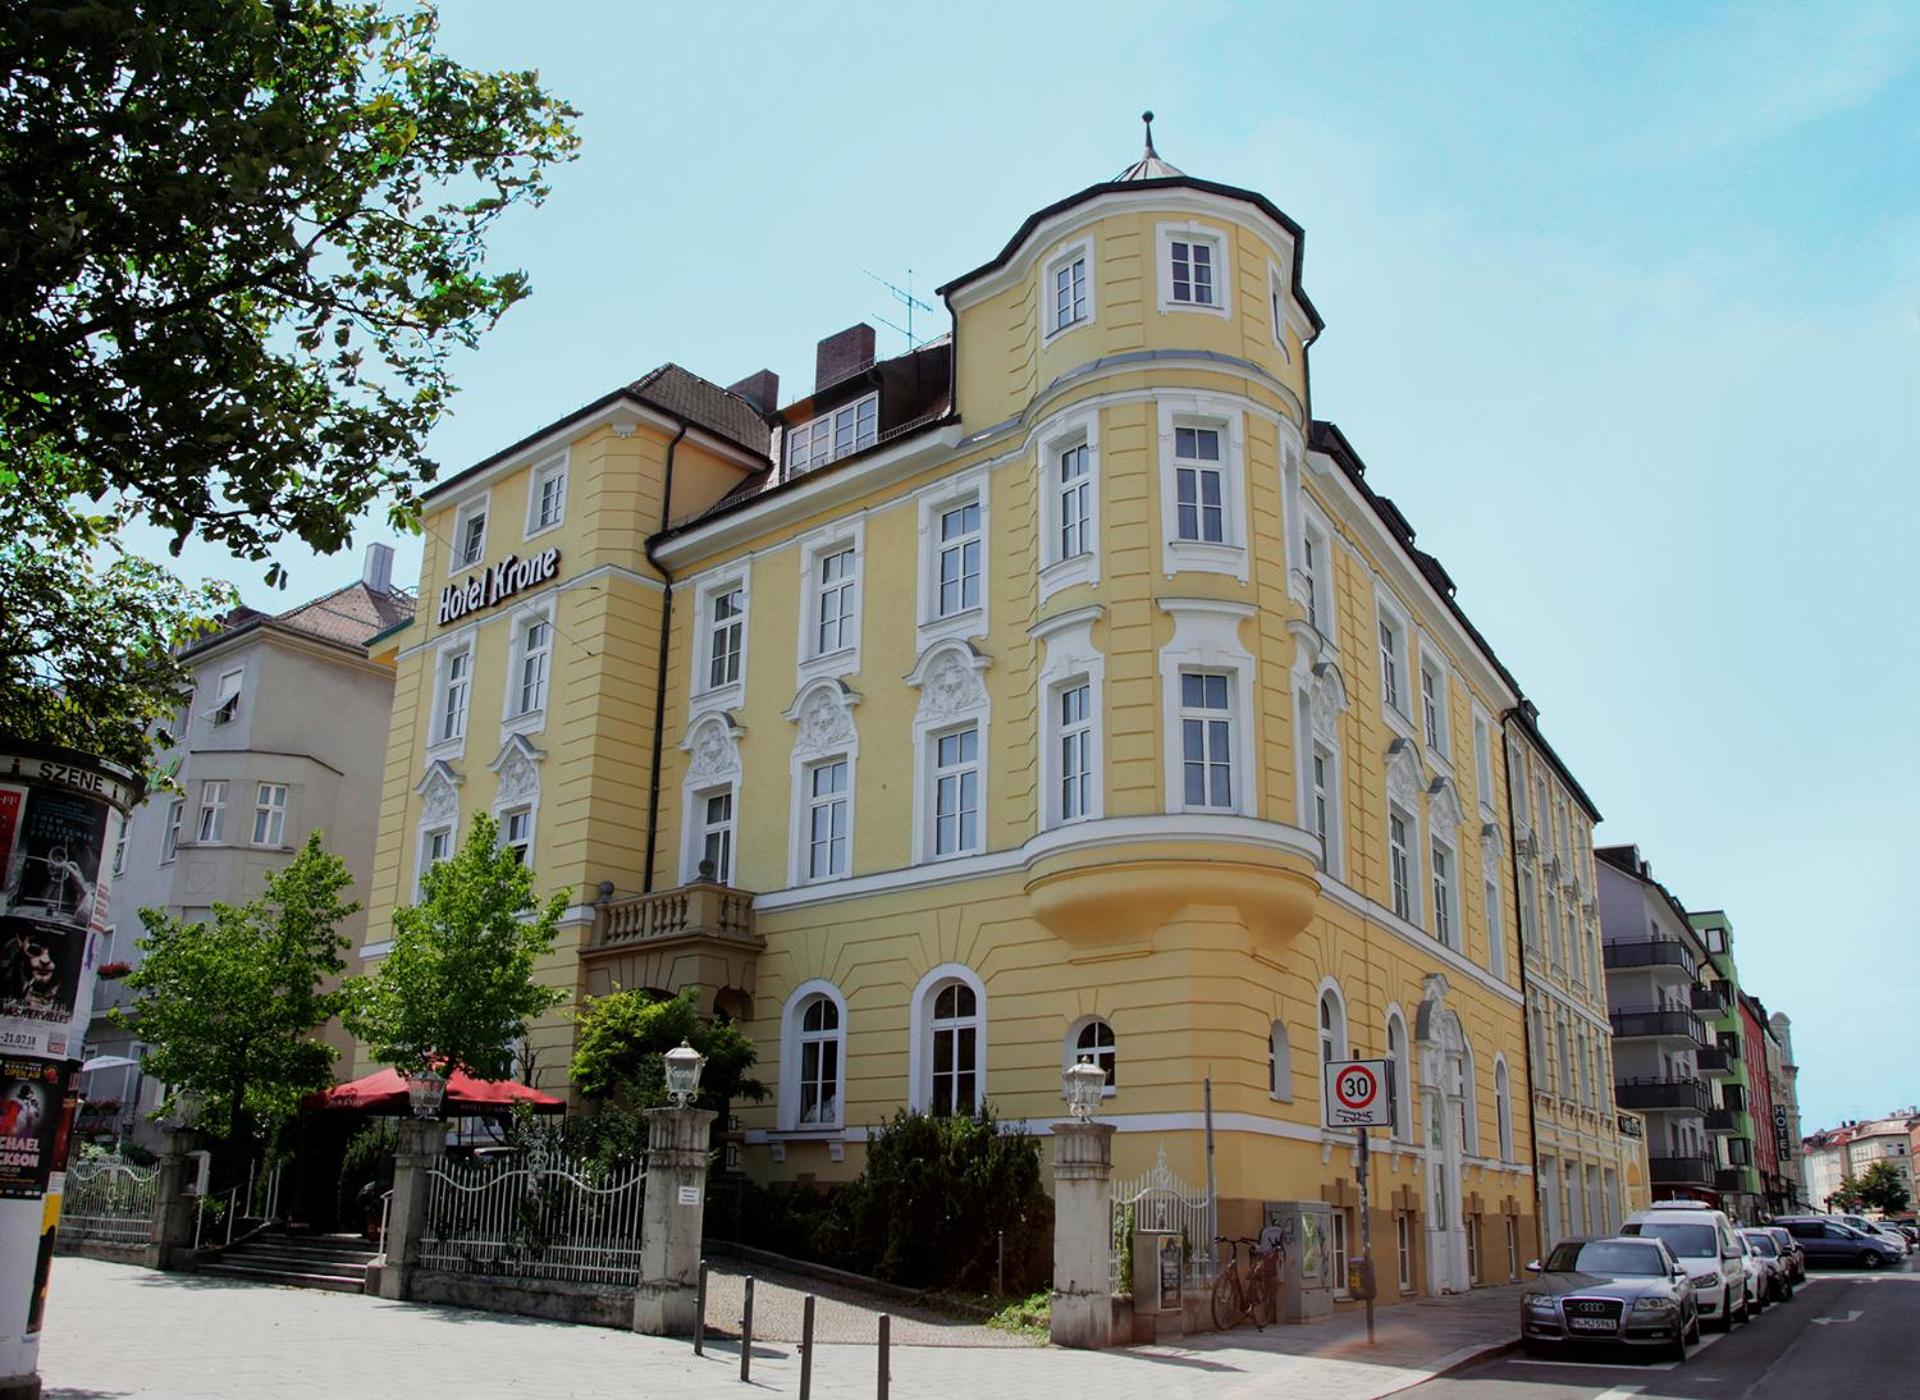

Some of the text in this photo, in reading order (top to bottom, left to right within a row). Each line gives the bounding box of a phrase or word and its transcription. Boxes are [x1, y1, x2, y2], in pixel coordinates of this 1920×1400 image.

[439, 548, 561, 625] Hotel Krone
[39, 762, 105, 793] SZENE
[4, 1069, 27, 1078] OPEN
[28, 1071, 41, 1080] AIR
[1344, 1077, 1368, 1097] 30
[1775, 1106, 1788, 1160] HOTEL
